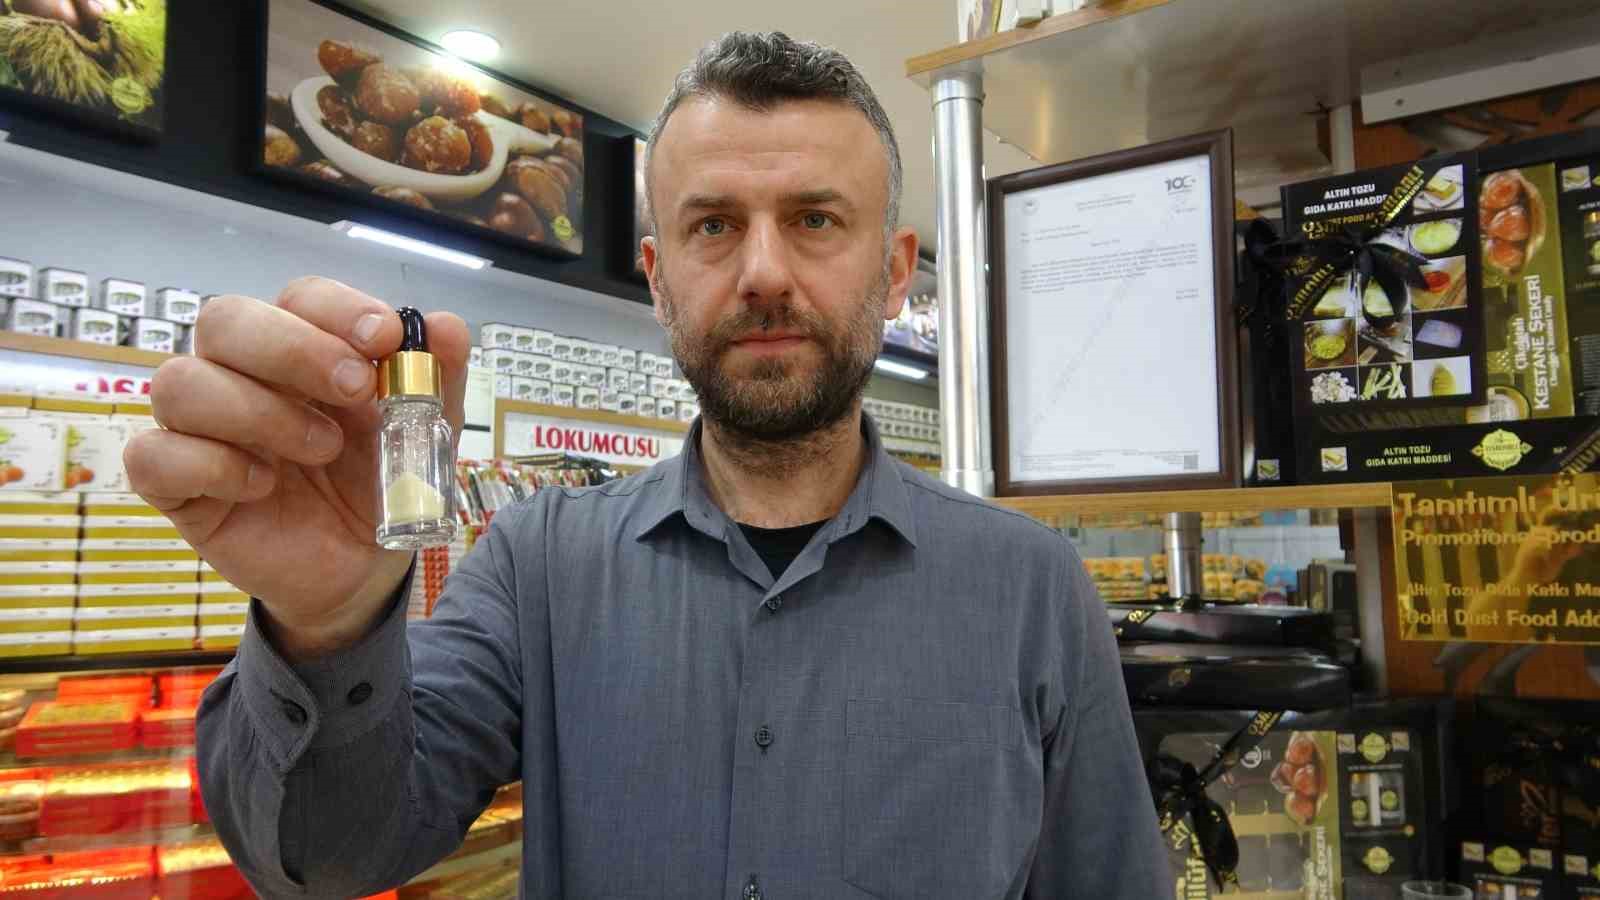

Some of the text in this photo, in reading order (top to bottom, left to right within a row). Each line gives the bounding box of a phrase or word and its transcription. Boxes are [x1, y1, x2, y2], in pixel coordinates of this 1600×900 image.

[1324, 184, 1376, 200] ALTIN TOZU
[1304, 203, 1326, 216] GIDA
[1327, 199, 1353, 212] KATKI
[1524, 274, 1549, 410] KESTANE ŞEKERİ
[534, 425, 660, 459] LOKUMCUSU
[1383, 444, 1431, 457] ALTIN TOZU
[1387, 456, 1412, 466] KATKI
[1526, 582, 1569, 598] Katkı
[1506, 608, 1558, 627] Food
